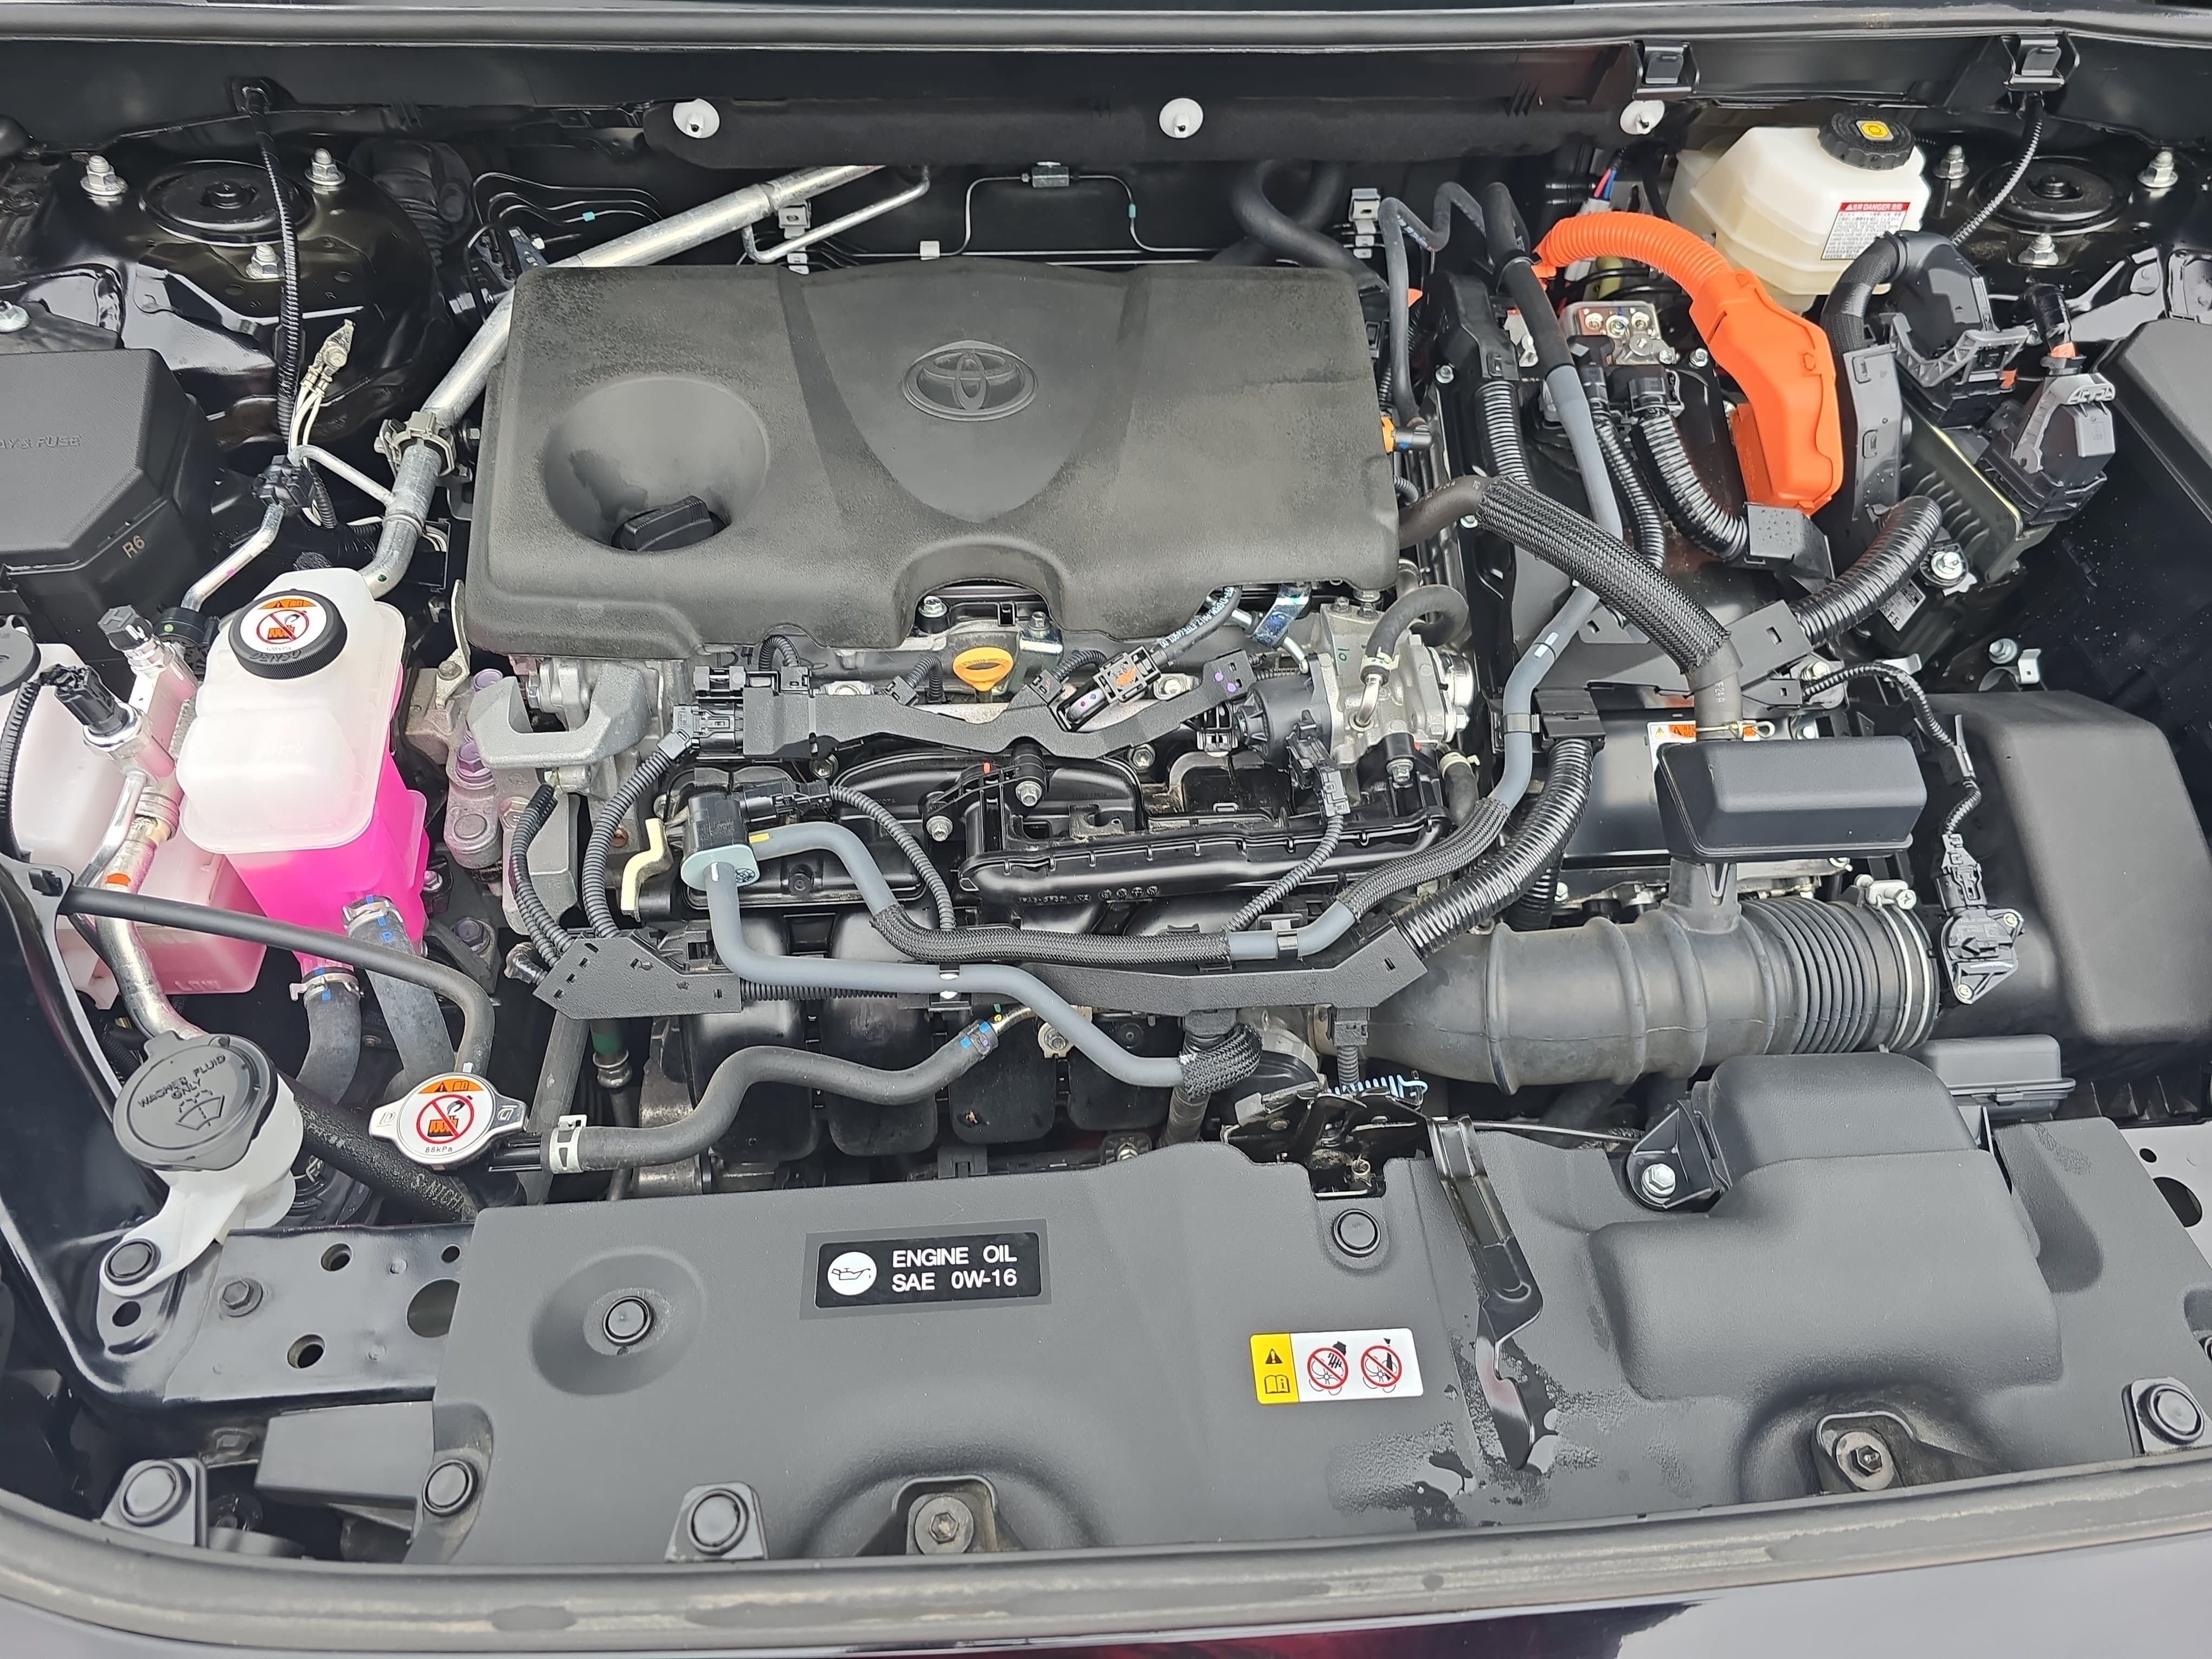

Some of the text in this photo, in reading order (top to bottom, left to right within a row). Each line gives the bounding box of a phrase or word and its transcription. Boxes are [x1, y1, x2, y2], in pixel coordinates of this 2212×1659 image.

[1863, 203, 1891, 211] DANGER
[37, 434, 83, 448] FUSE
[121, 535, 145, 559] R6
[249, 649, 301, 663] DENSO
[193, 1054, 226, 1077] FLUID
[171, 1077, 201, 1099] ONLY
[892, 1244, 1018, 1268] ENGINE OIL
[891, 1268, 1018, 1293] SAE 0W-16
